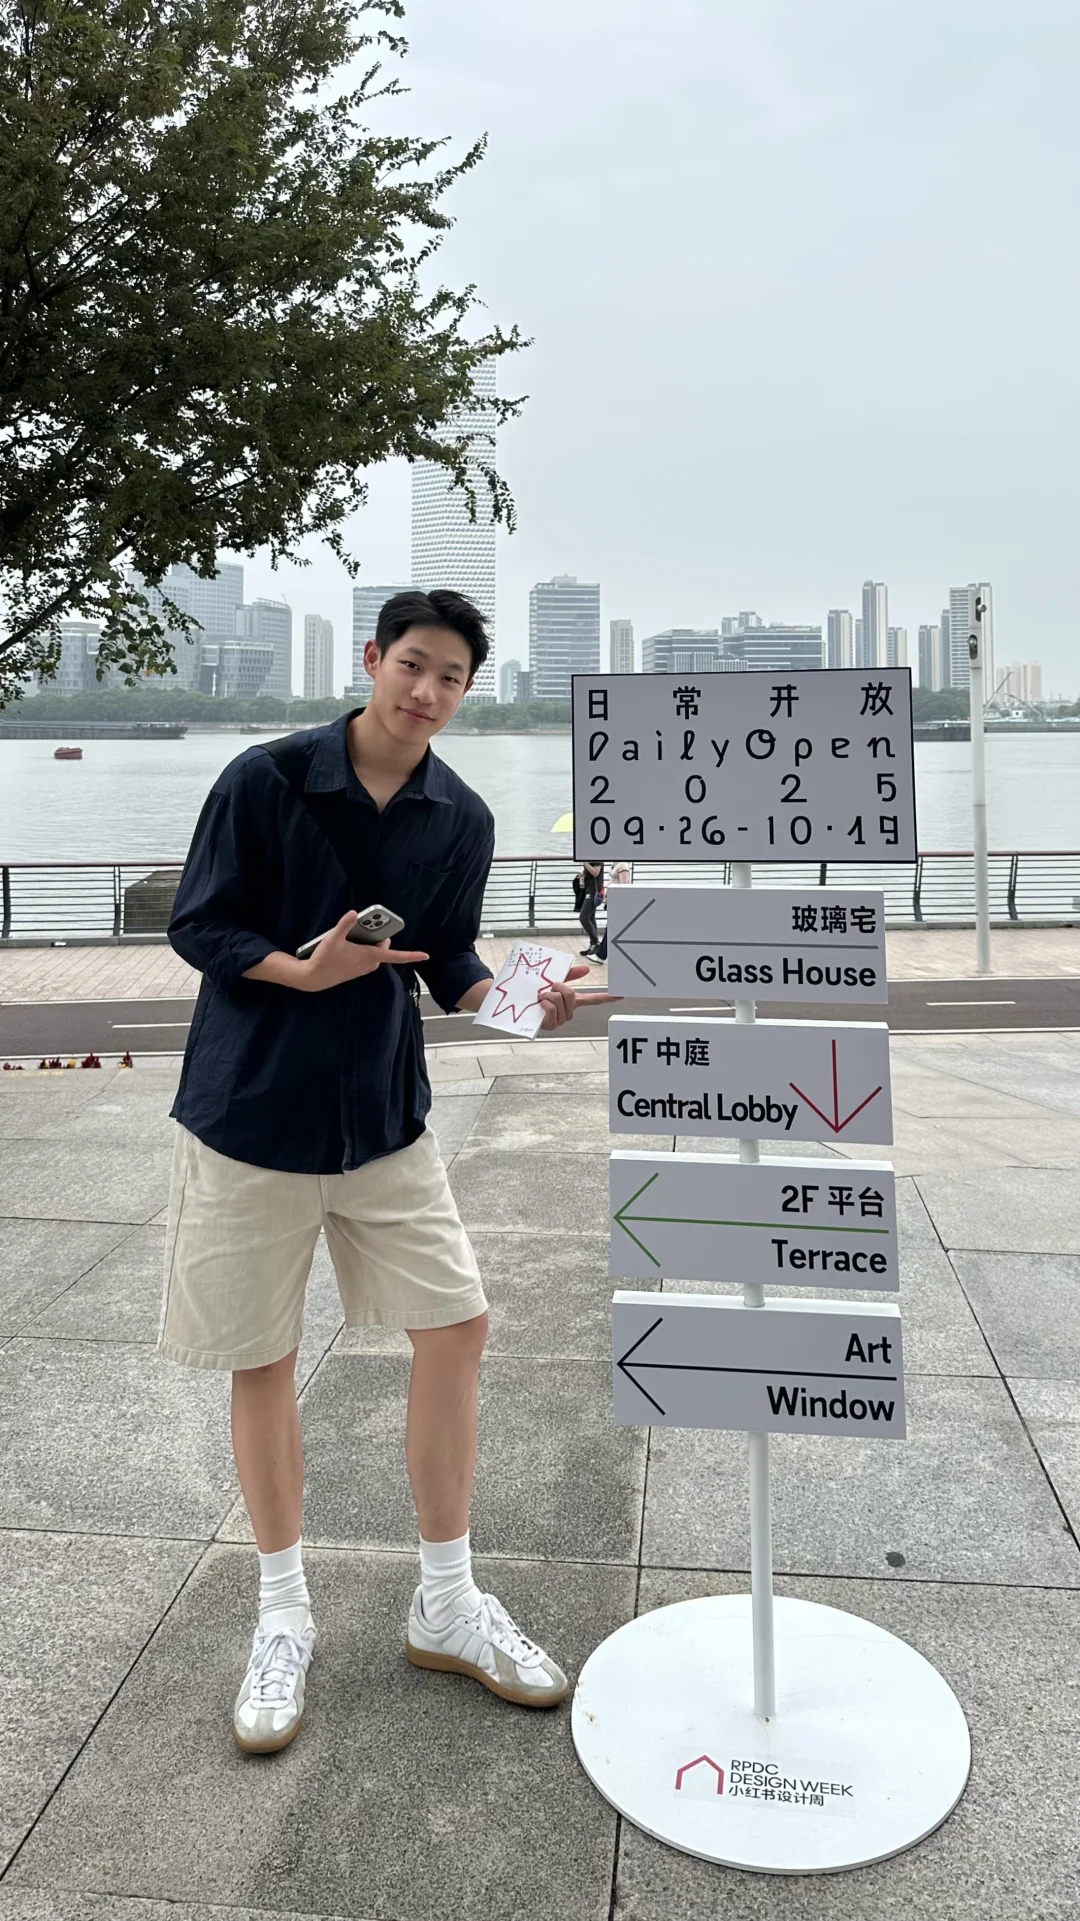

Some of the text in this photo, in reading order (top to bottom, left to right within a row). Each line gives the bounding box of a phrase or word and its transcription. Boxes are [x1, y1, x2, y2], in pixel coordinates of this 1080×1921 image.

[791, 904, 877, 934] 玻璃宅
[695, 955, 877, 987] Glass House
[616, 1036, 711, 1067] 1F 中庭
[617, 1089, 799, 1131] Central Lobby
[781, 1184, 885, 1218] 2F 平台
[770, 1238, 888, 1274] Terrace
[844, 1332, 893, 1364] Art
[766, 1385, 896, 1422] Window
[730, 1760, 779, 1775] RPDC
[728, 1785, 824, 1806] 小红书设计周
[730, 1772, 855, 1798] DESIGN WEEK
